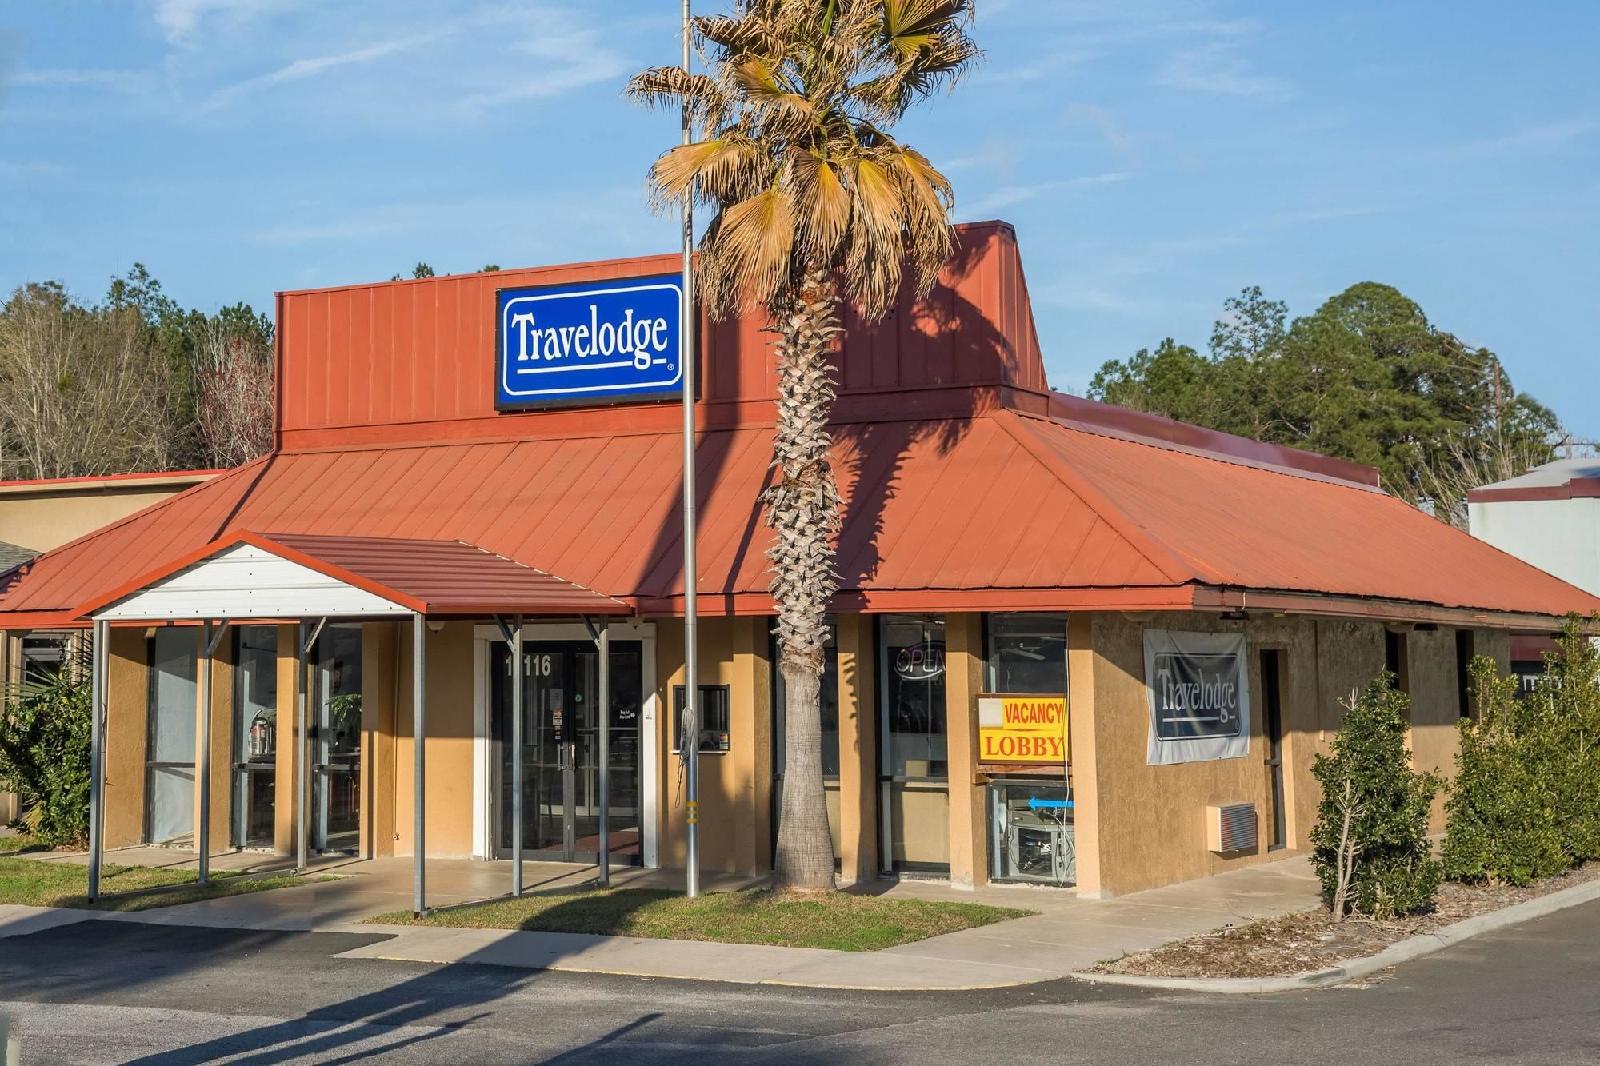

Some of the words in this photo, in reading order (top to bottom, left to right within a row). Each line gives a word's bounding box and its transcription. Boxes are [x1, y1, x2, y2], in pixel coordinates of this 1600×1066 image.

[511, 304, 668, 370] Travelodge
[505, 654, 551, 677] 1116
[1157, 668, 1236, 724] Travelodge
[1005, 702, 1063, 724] VACANCY
[984, 735, 1065, 757] LOBBY
